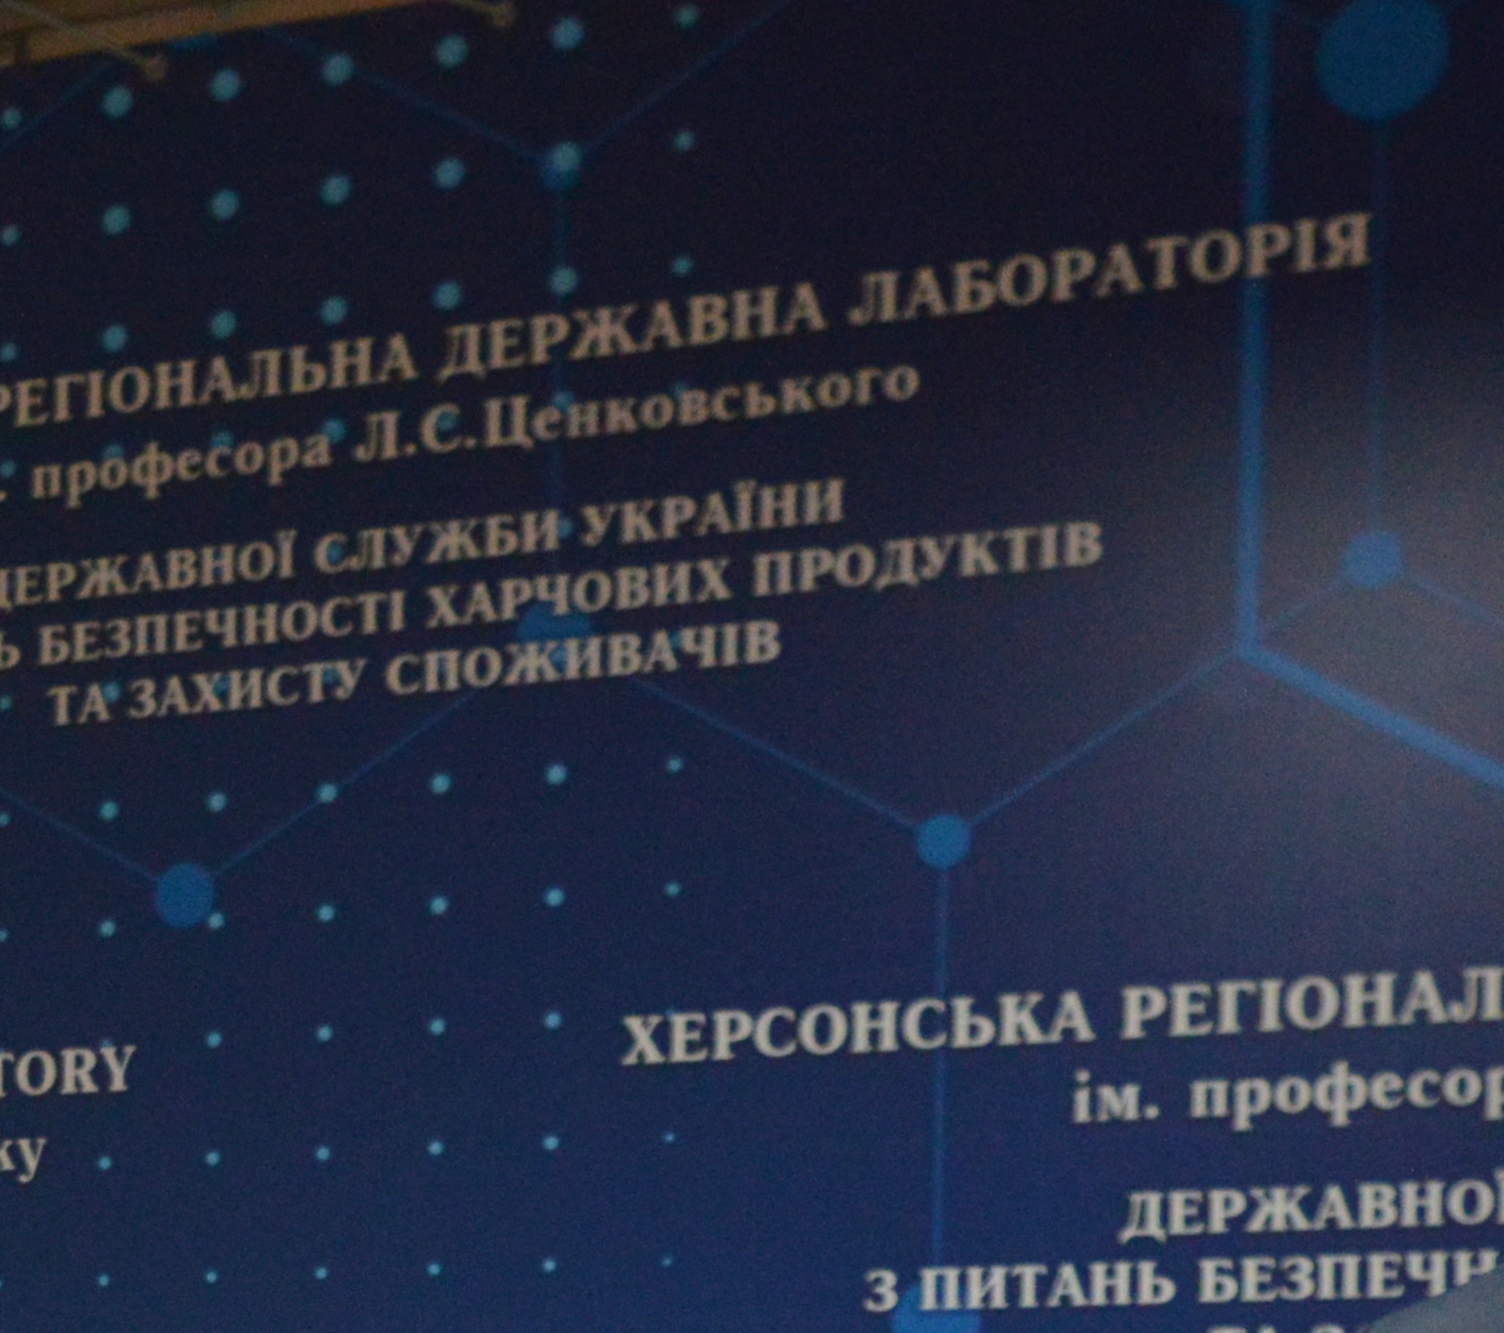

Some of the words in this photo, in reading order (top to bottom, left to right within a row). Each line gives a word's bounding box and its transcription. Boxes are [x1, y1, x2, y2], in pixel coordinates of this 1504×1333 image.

[437, 280, 828, 381] ДЕРЖАВНА
[846, 210, 1372, 327] ЛАБОРАТОРІЯ
[29, 432, 334, 511] професора
[351, 363, 922, 464] Л.С.Ценковського
[311, 506, 563, 575] СЛУЖБИ
[579, 475, 846, 547] УКРАЇНИ
[37, 588, 406, 668] БЕЗПЕЧНОСТІ
[426, 557, 732, 629] ХАРЧОВИХ
[752, 519, 1105, 598] ПРОДУКТІВ
[46, 681, 113, 728] ТА
[126, 656, 368, 721] ЗАХИСТУ
[382, 617, 784, 698] СПОЖИВАЧІВ
[619, 988, 1097, 1068] ХЕРСОНСЬКА
[1070, 1067, 1162, 1126] ім.
[863, 1267, 900, 1315] З
[919, 1258, 1179, 1311] ПИТАНЬ
